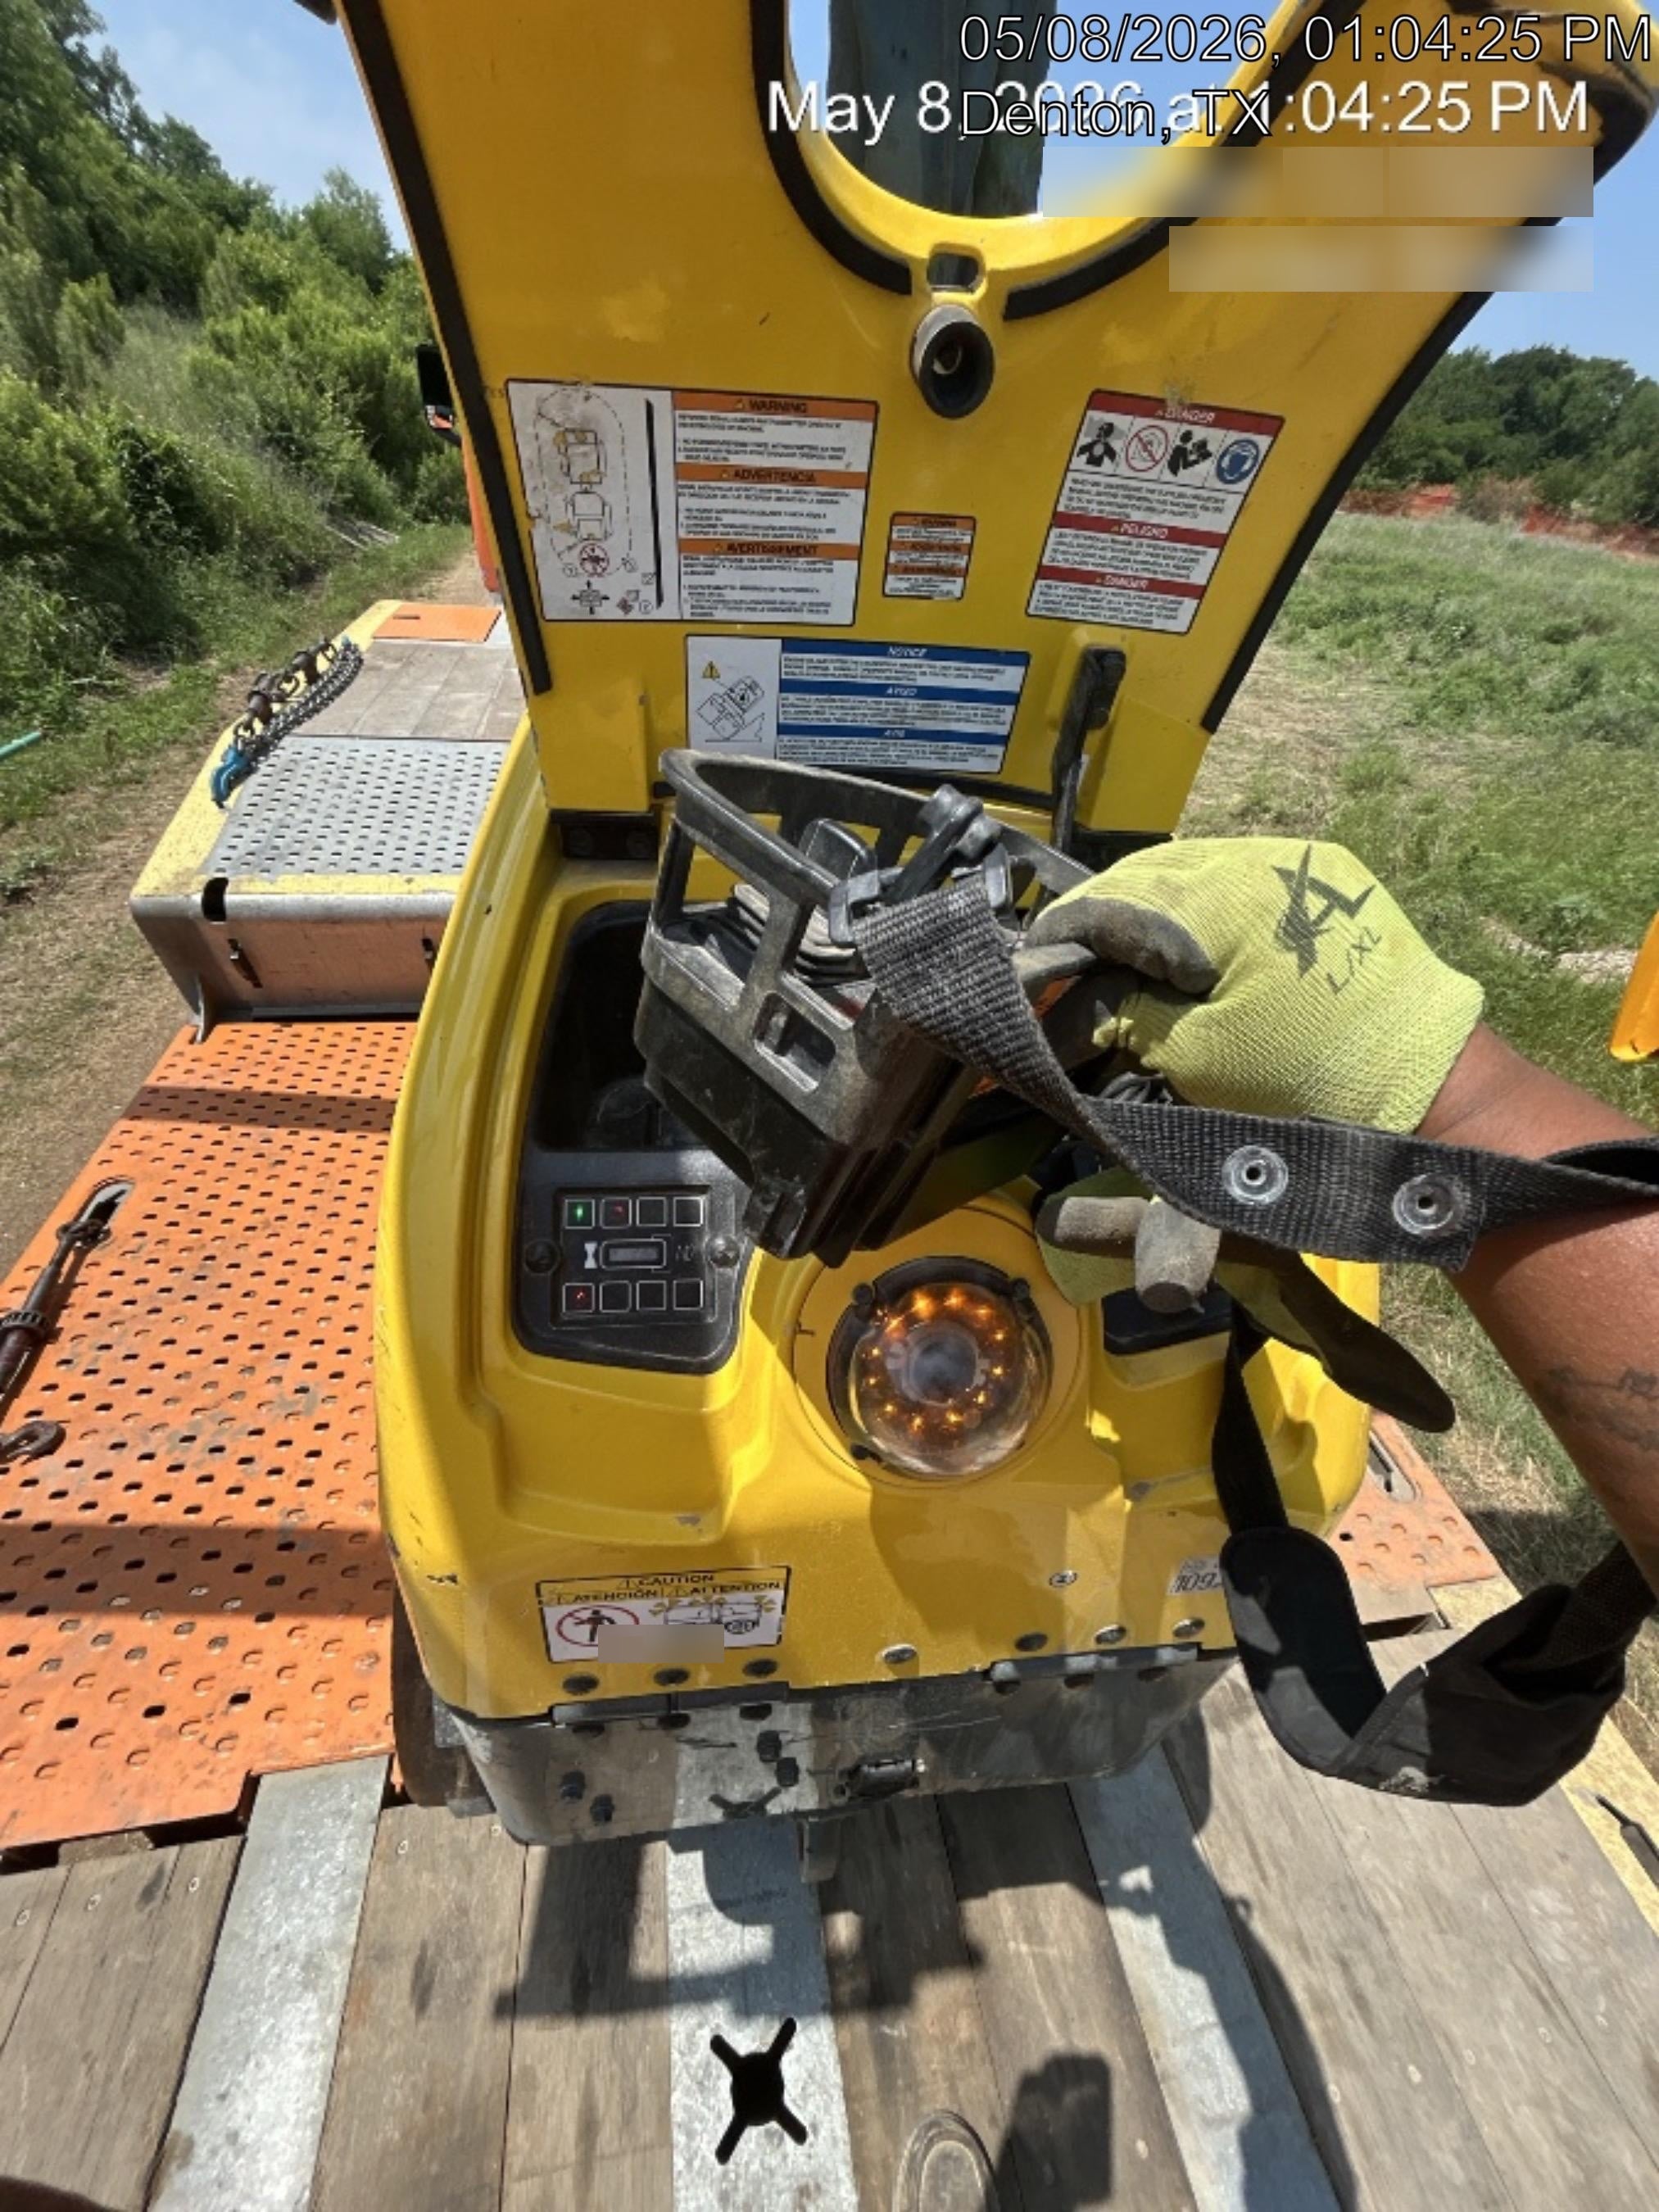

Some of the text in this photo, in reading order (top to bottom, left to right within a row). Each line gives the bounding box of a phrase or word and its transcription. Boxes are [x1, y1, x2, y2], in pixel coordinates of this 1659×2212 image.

[749, 400, 808, 413] WARNING
[733, 469, 816, 483] ADVERTENCIA
[639, 1573, 715, 1588] CAUTION
[690, 1581, 780, 1595] ATTENTION
